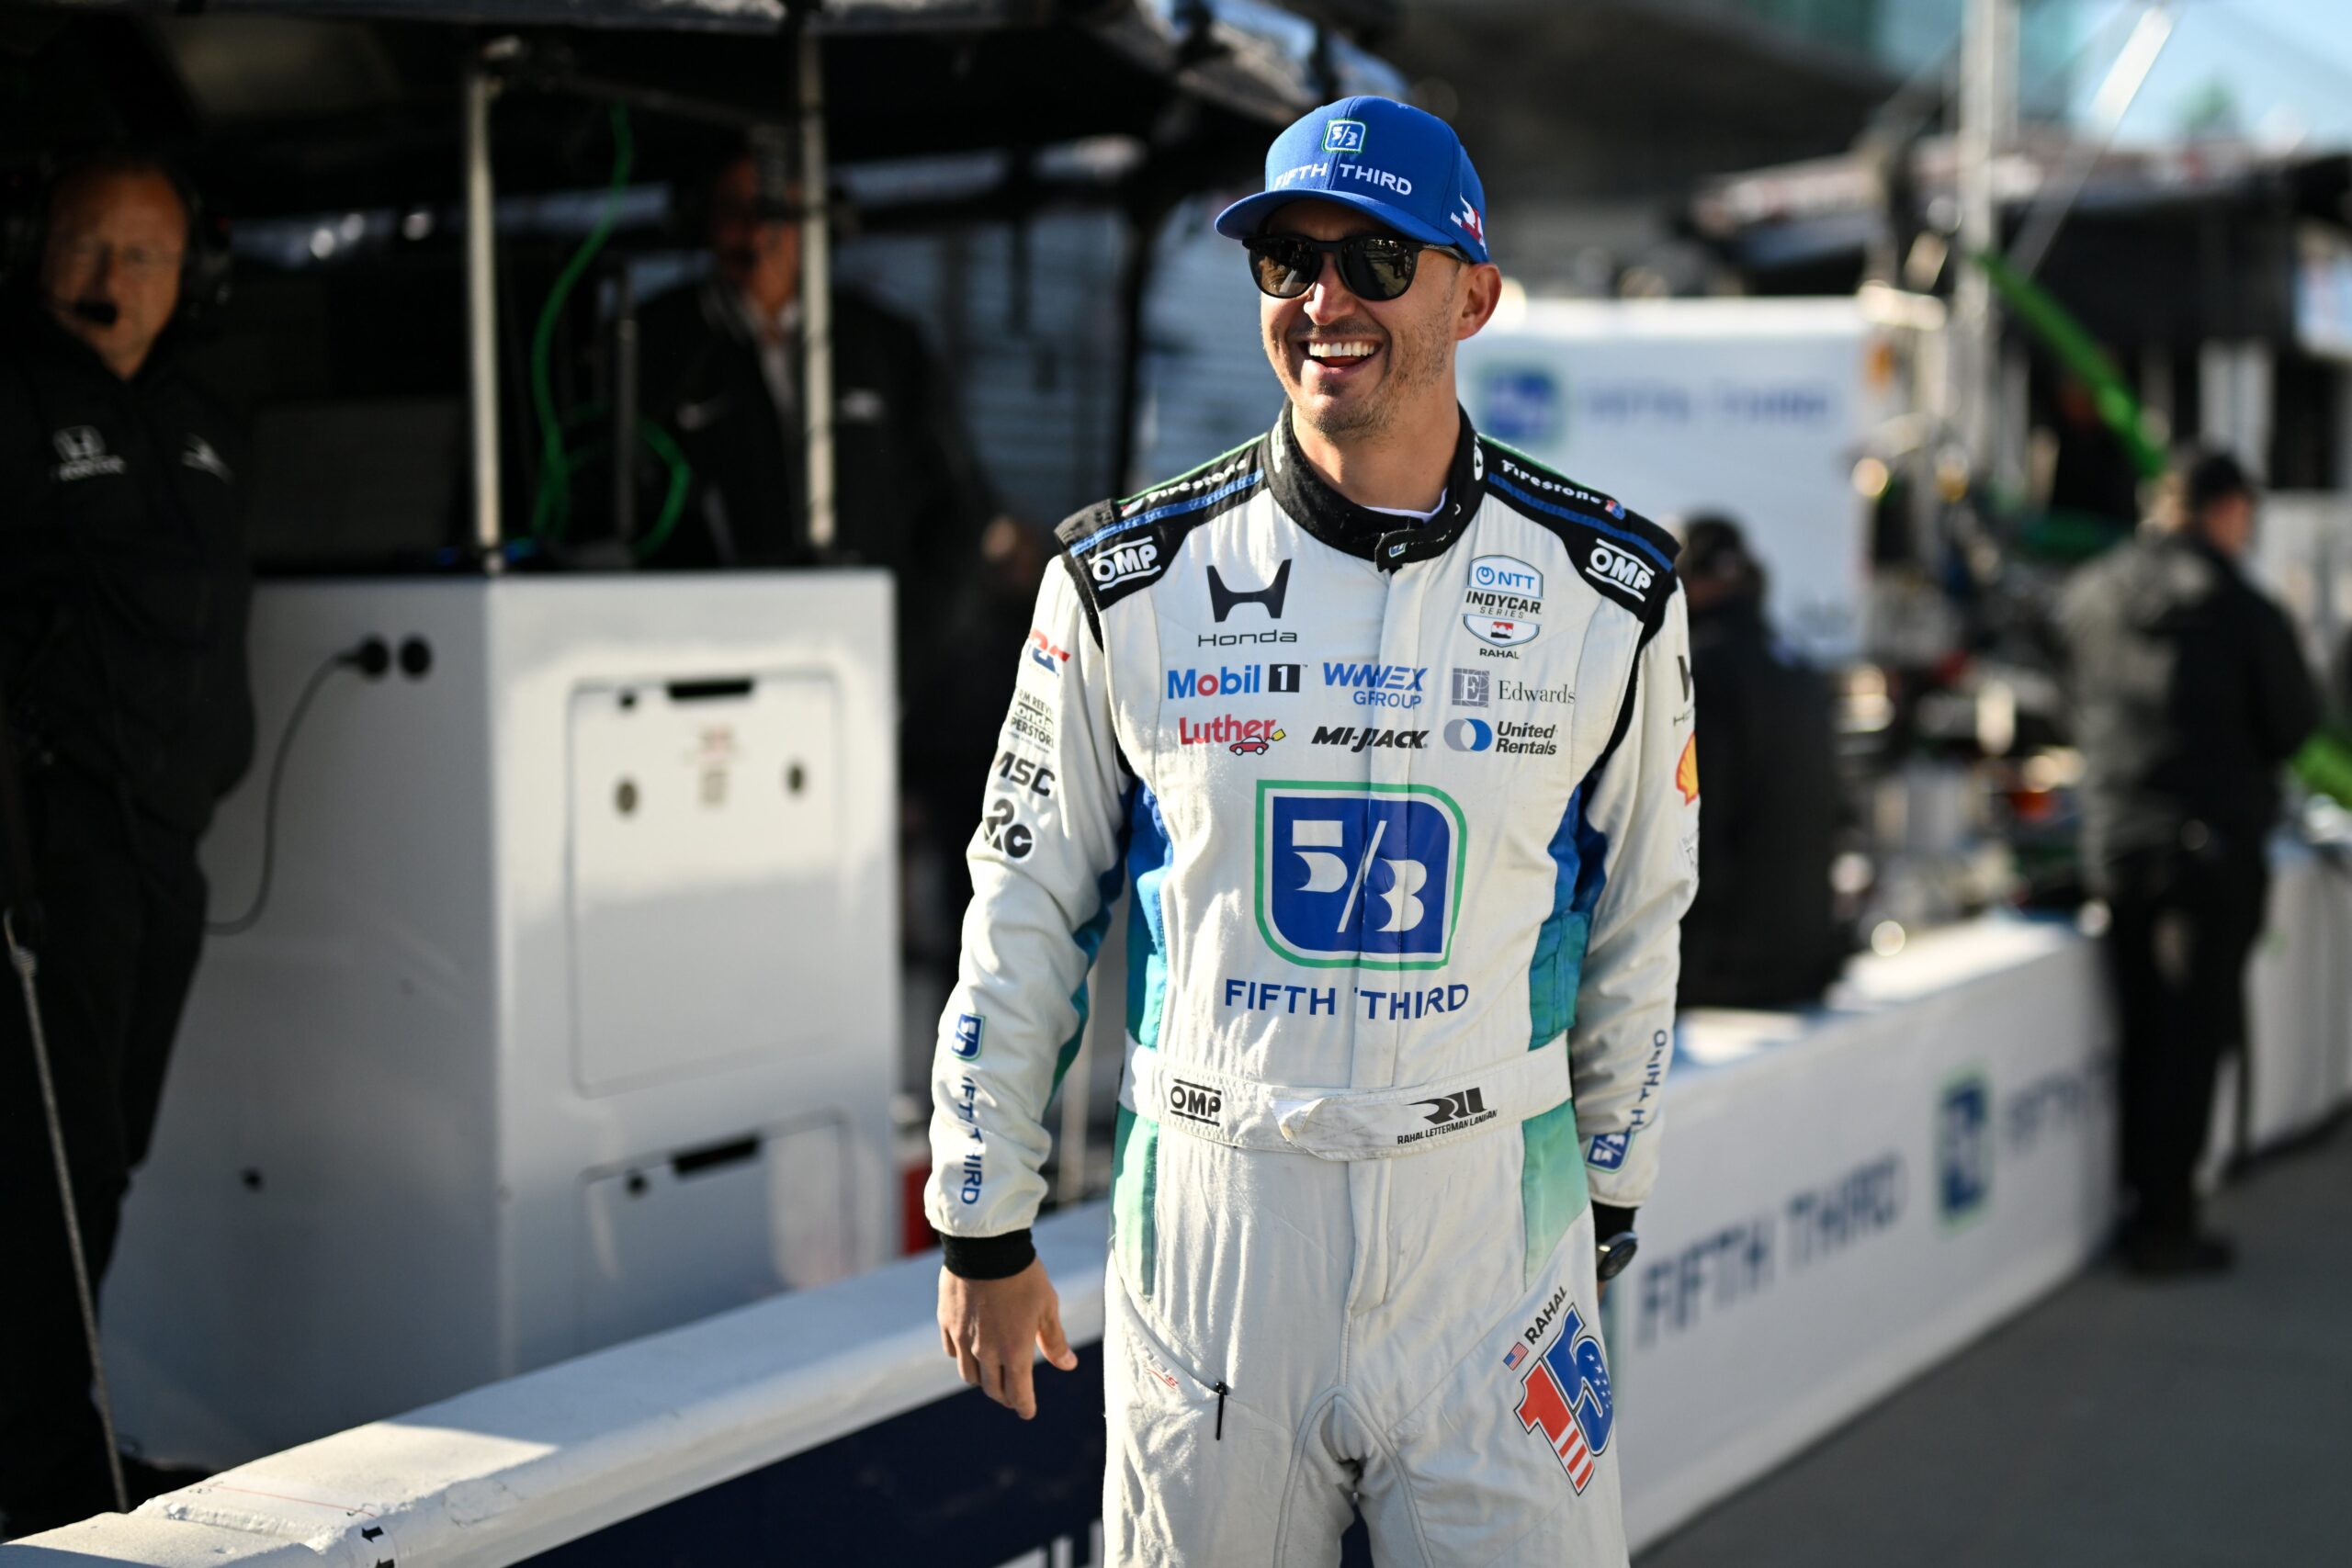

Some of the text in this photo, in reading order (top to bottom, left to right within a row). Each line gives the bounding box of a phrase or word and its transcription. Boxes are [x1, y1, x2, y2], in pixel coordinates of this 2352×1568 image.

[1272, 163, 1412, 196] FIFTH THIRD
[1501, 458, 1604, 505] Firestone
[1091, 542, 1159, 582] OMP
[1589, 547, 1652, 592] OMP
[1498, 570, 1535, 590] NTT
[1464, 591, 1541, 615] INDYCAR
[1479, 606, 1524, 619] SERIES
[1198, 629, 1297, 647] Honda
[1479, 648, 1520, 660] RAHAL
[1168, 664, 1261, 699] Mobil
[1498, 680, 1576, 705] Edwards
[1353, 691, 1421, 709] GROUP
[1179, 714, 1276, 745] Luther
[1311, 726, 1430, 753] MI-JACK
[1497, 721, 1556, 739] United
[1496, 738, 1557, 756] Rentals
[1291, 819, 1428, 934] 5/3
[1225, 978, 1470, 1021] FIFTH THIRD
[1170, 1086, 1221, 1118] OMP
[1396, 1131, 1424, 1145] RAHAL
[1425, 1119, 1469, 1138] LETTERMAN
[1524, 1286, 1567, 1345] RAHAL
[1514, 1303, 1614, 1496] 15
